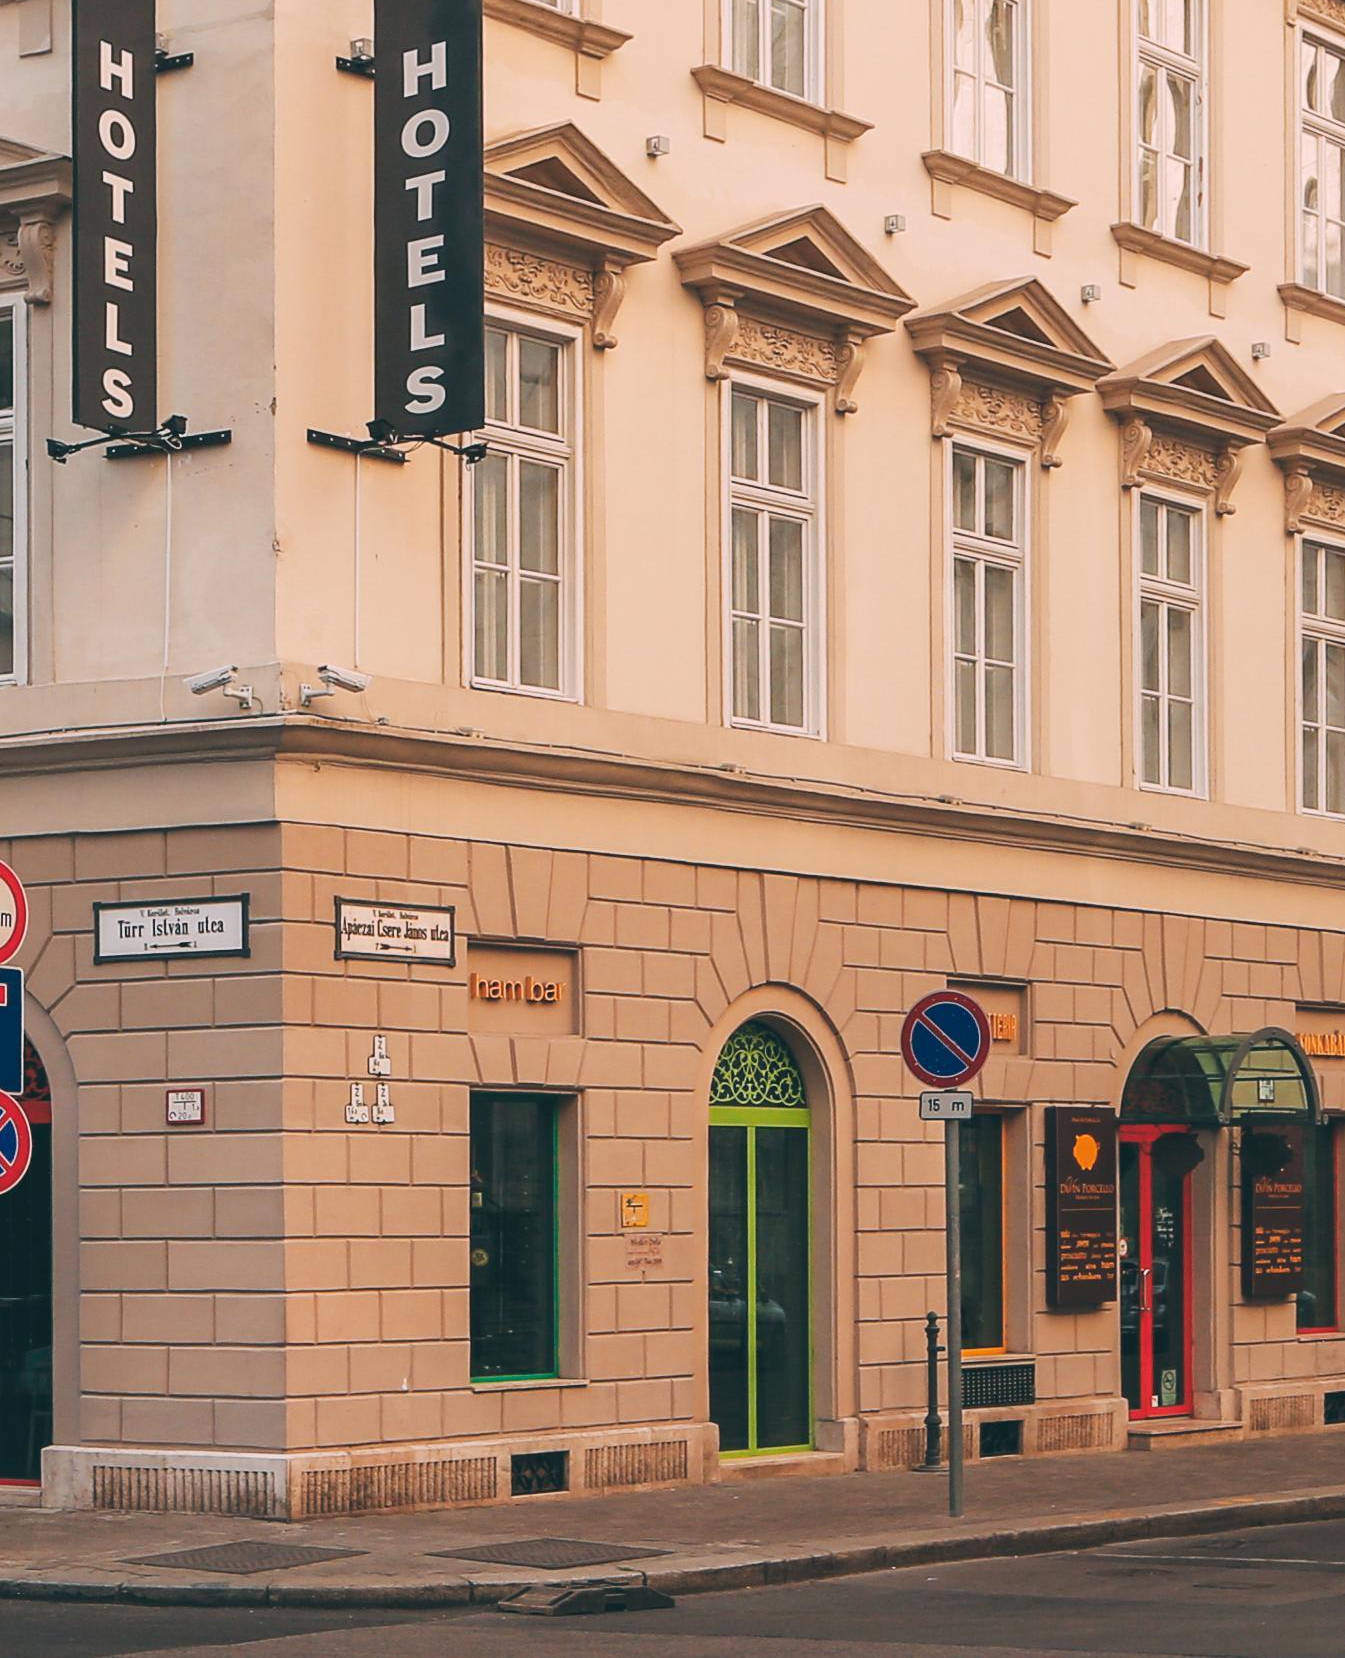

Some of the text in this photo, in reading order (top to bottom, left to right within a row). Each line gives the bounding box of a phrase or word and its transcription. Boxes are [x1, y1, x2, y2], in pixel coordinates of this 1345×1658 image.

[98, 39, 137, 420] HOTELS
[400, 39, 451, 416] HOTELS
[117, 916, 224, 939] Türr István utca
[340, 917, 449, 942] Apáczai Csere János utca
[471, 973, 567, 1004] ham bar
[927, 1098, 965, 1112] 15 m
